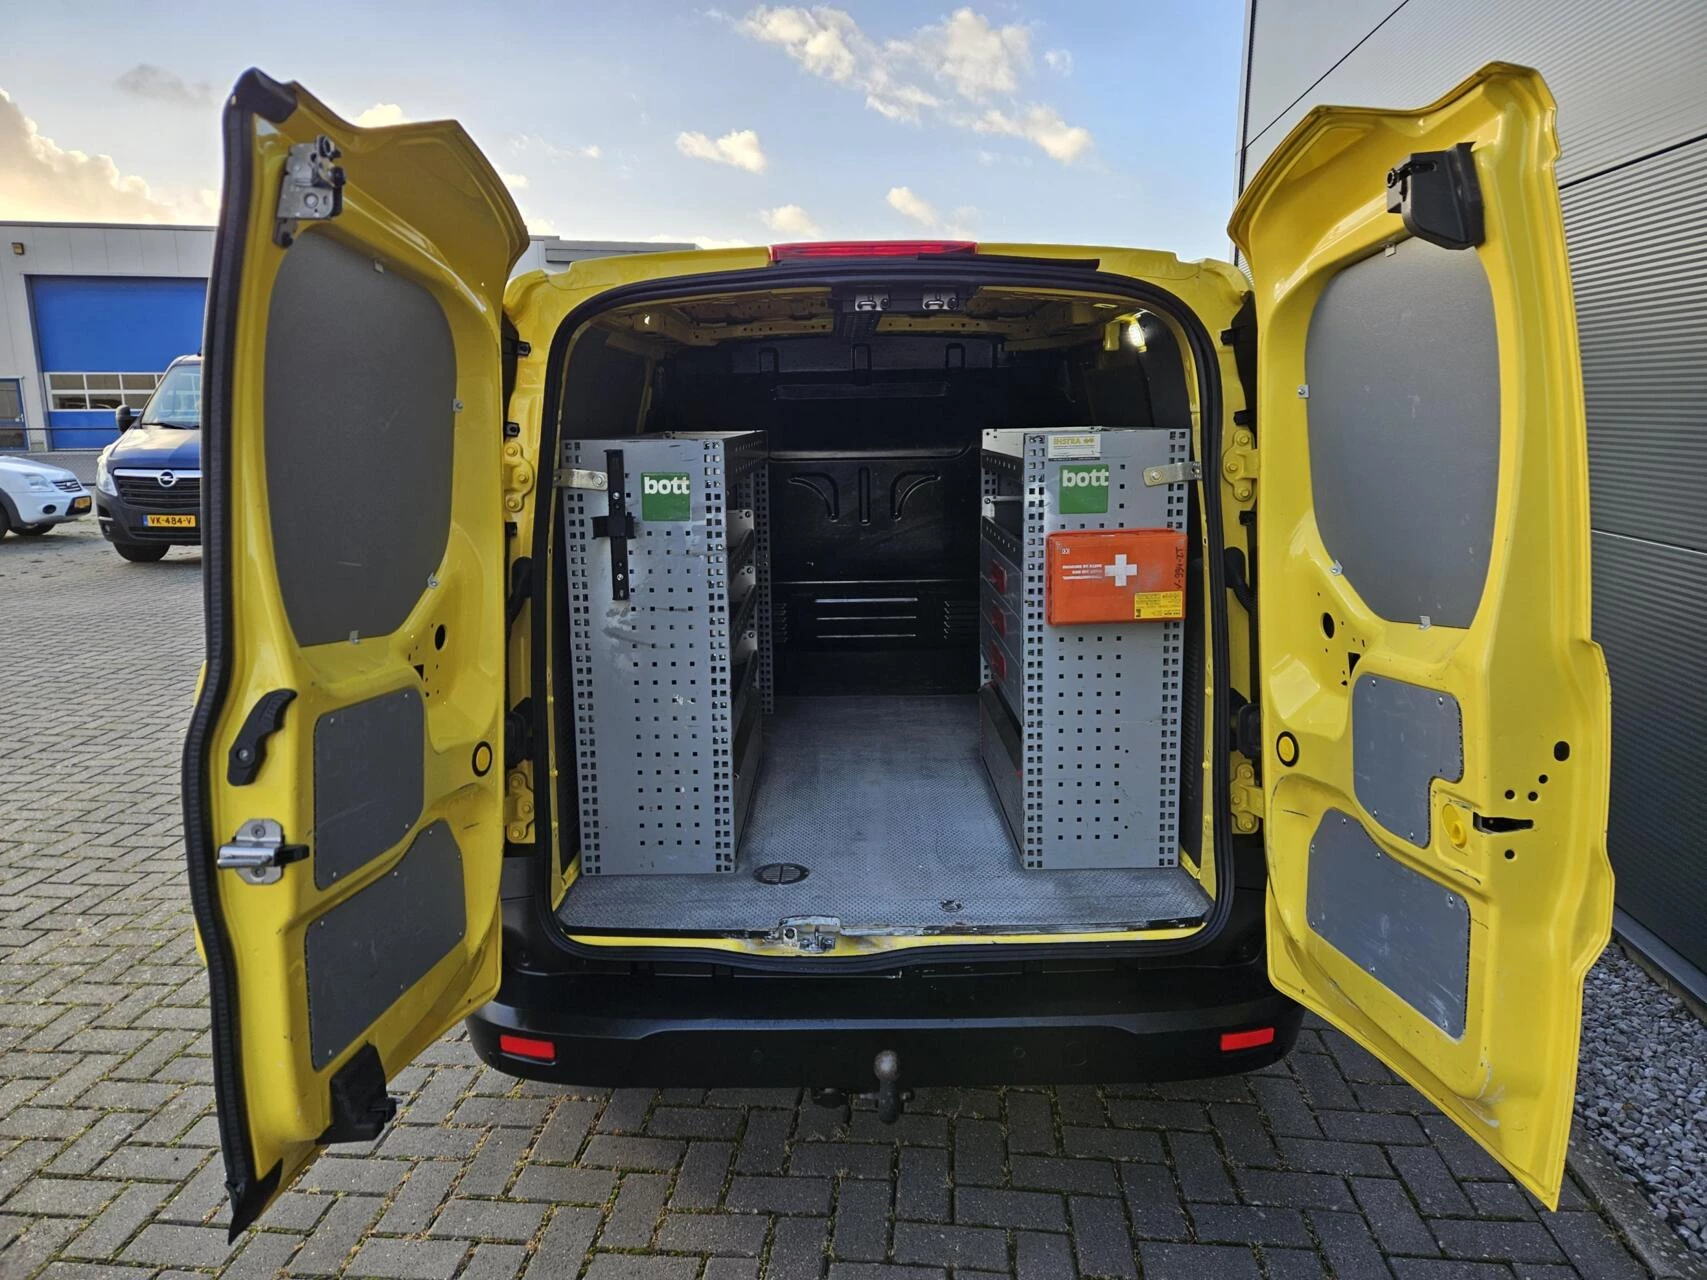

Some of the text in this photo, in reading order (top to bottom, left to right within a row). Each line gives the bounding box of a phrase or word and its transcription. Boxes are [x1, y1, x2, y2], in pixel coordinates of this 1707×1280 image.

[644, 476, 690, 495] bott
[1062, 468, 1109, 487] bott
[150, 516, 192, 525] VK-484-V
